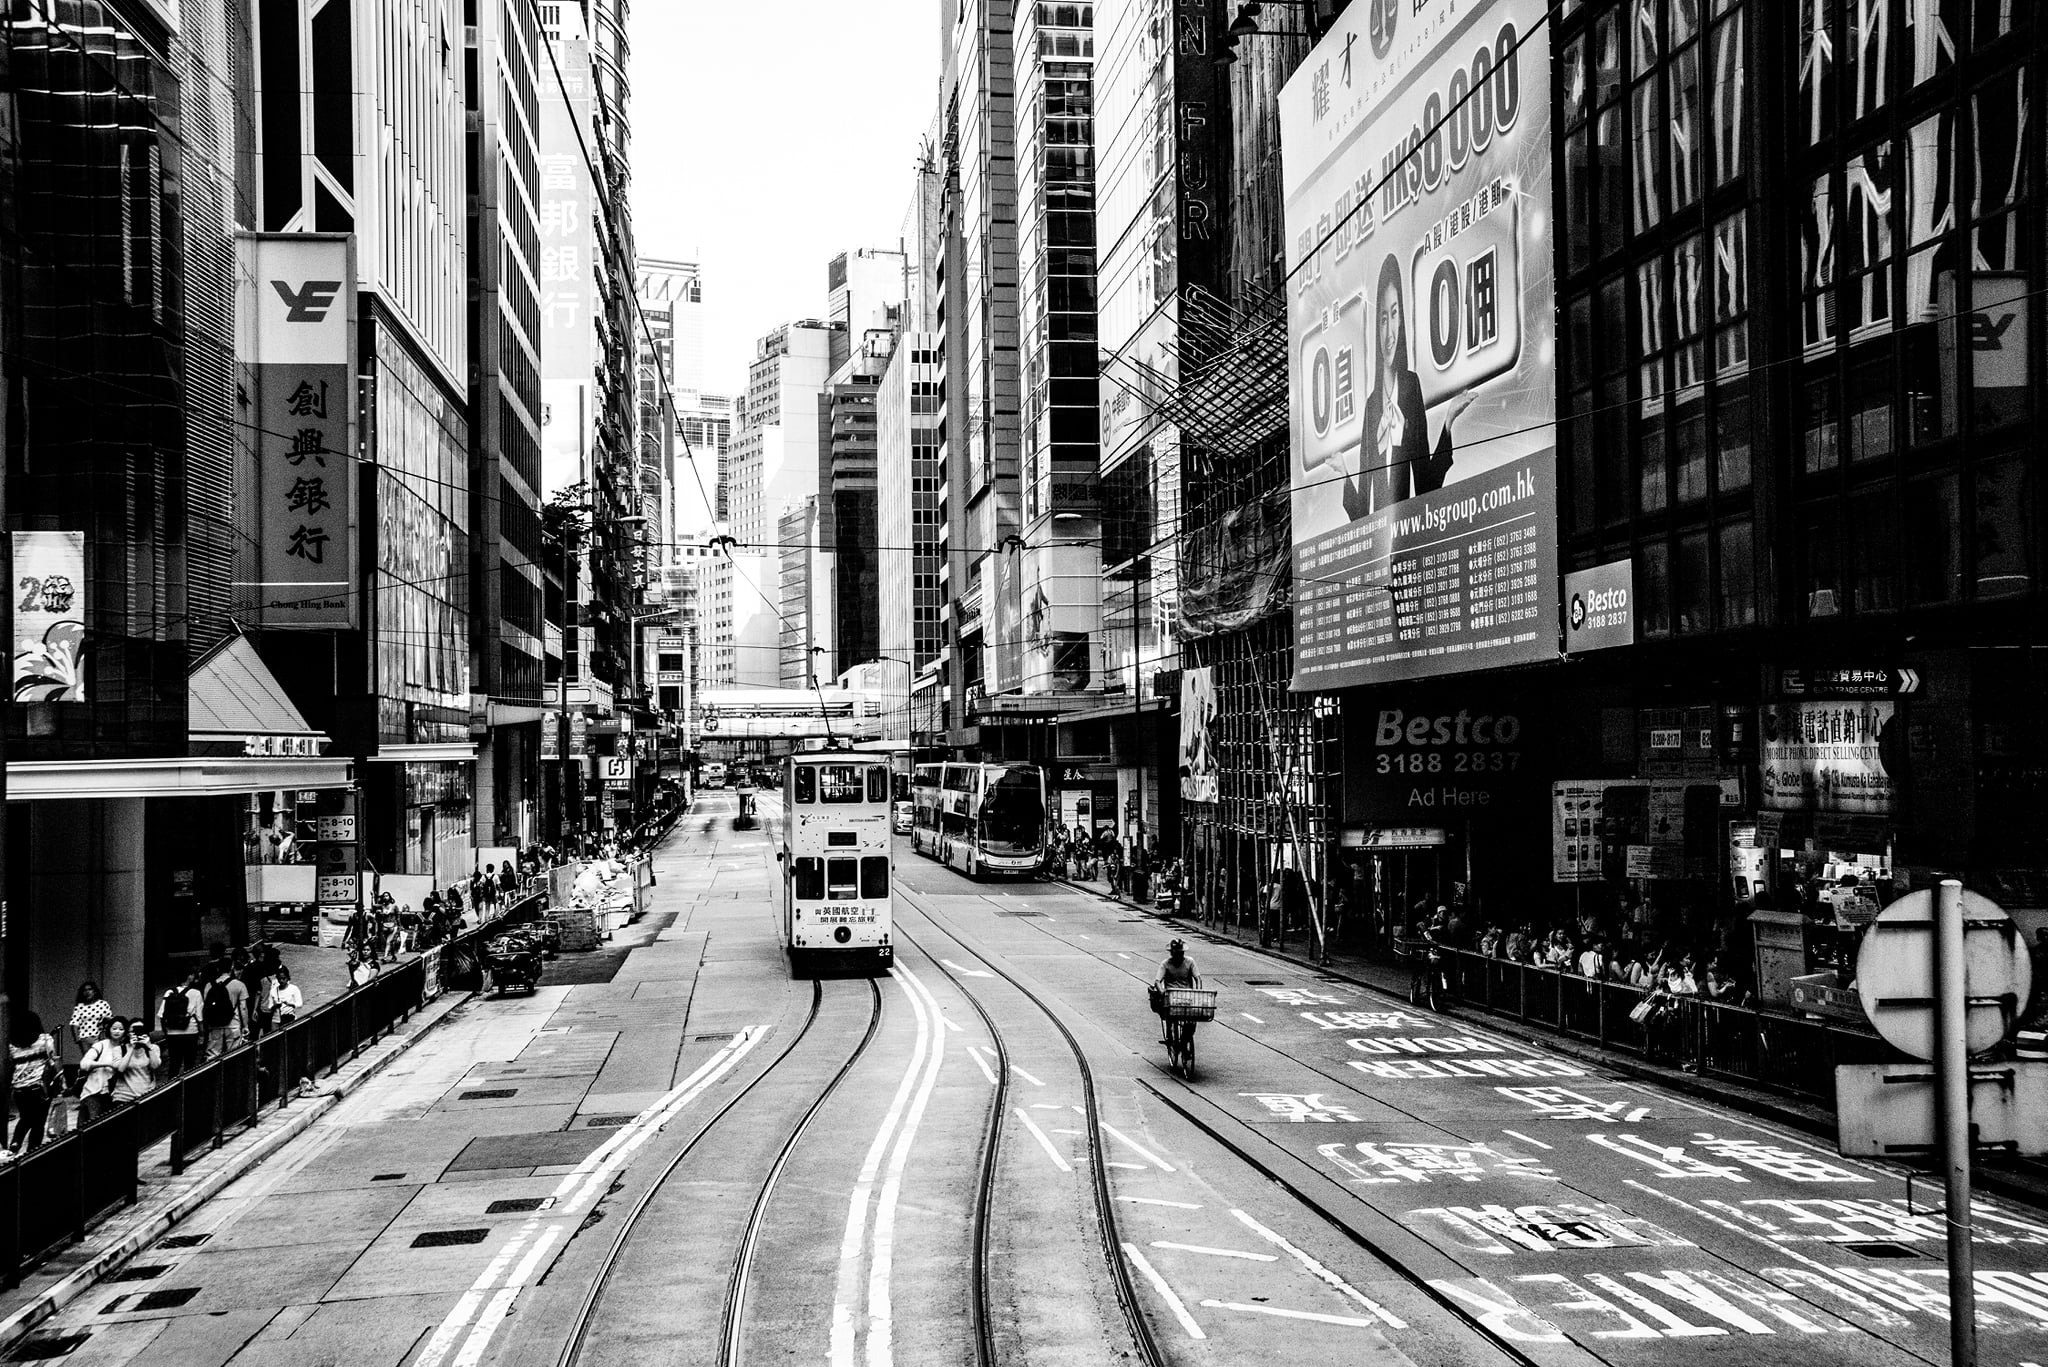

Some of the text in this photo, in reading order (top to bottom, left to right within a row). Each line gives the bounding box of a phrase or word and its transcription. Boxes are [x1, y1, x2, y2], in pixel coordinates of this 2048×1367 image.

[1180, 101, 1209, 240] FUR
[541, 152, 580, 329] 富邦銀行
[285, 379, 331, 564] 創興銀行
[1390, 467, 1535, 539] www.bsgroup.com.hk
[270, 598, 346, 611] Chong Hing Bank
[1587, 587, 1627, 613] Bestco
[1587, 611, 1627, 629] 3188 2837
[1860, 686, 1889, 694] CENTRE
[1374, 708, 1521, 747] Bestco
[1766, 746, 1788, 760] MOBILE
[1789, 746, 1809, 760] PHONE
[1810, 746, 1831, 760] DIRECT
[1833, 746, 1859, 760] SELLING
[1376, 751, 1521, 774] 3188 2837
[1407, 787, 1491, 807] Ad Here
[331, 818, 354, 827] 8-10
[332, 830, 350, 838] 5-7
[332, 878, 354, 886] 8-10
[332, 889, 349, 898] 4-7
[879, 948, 890, 957] 22
[1347, 1037, 1500, 1053] ROAD
[1347, 1059, 1583, 1078] CHATER
